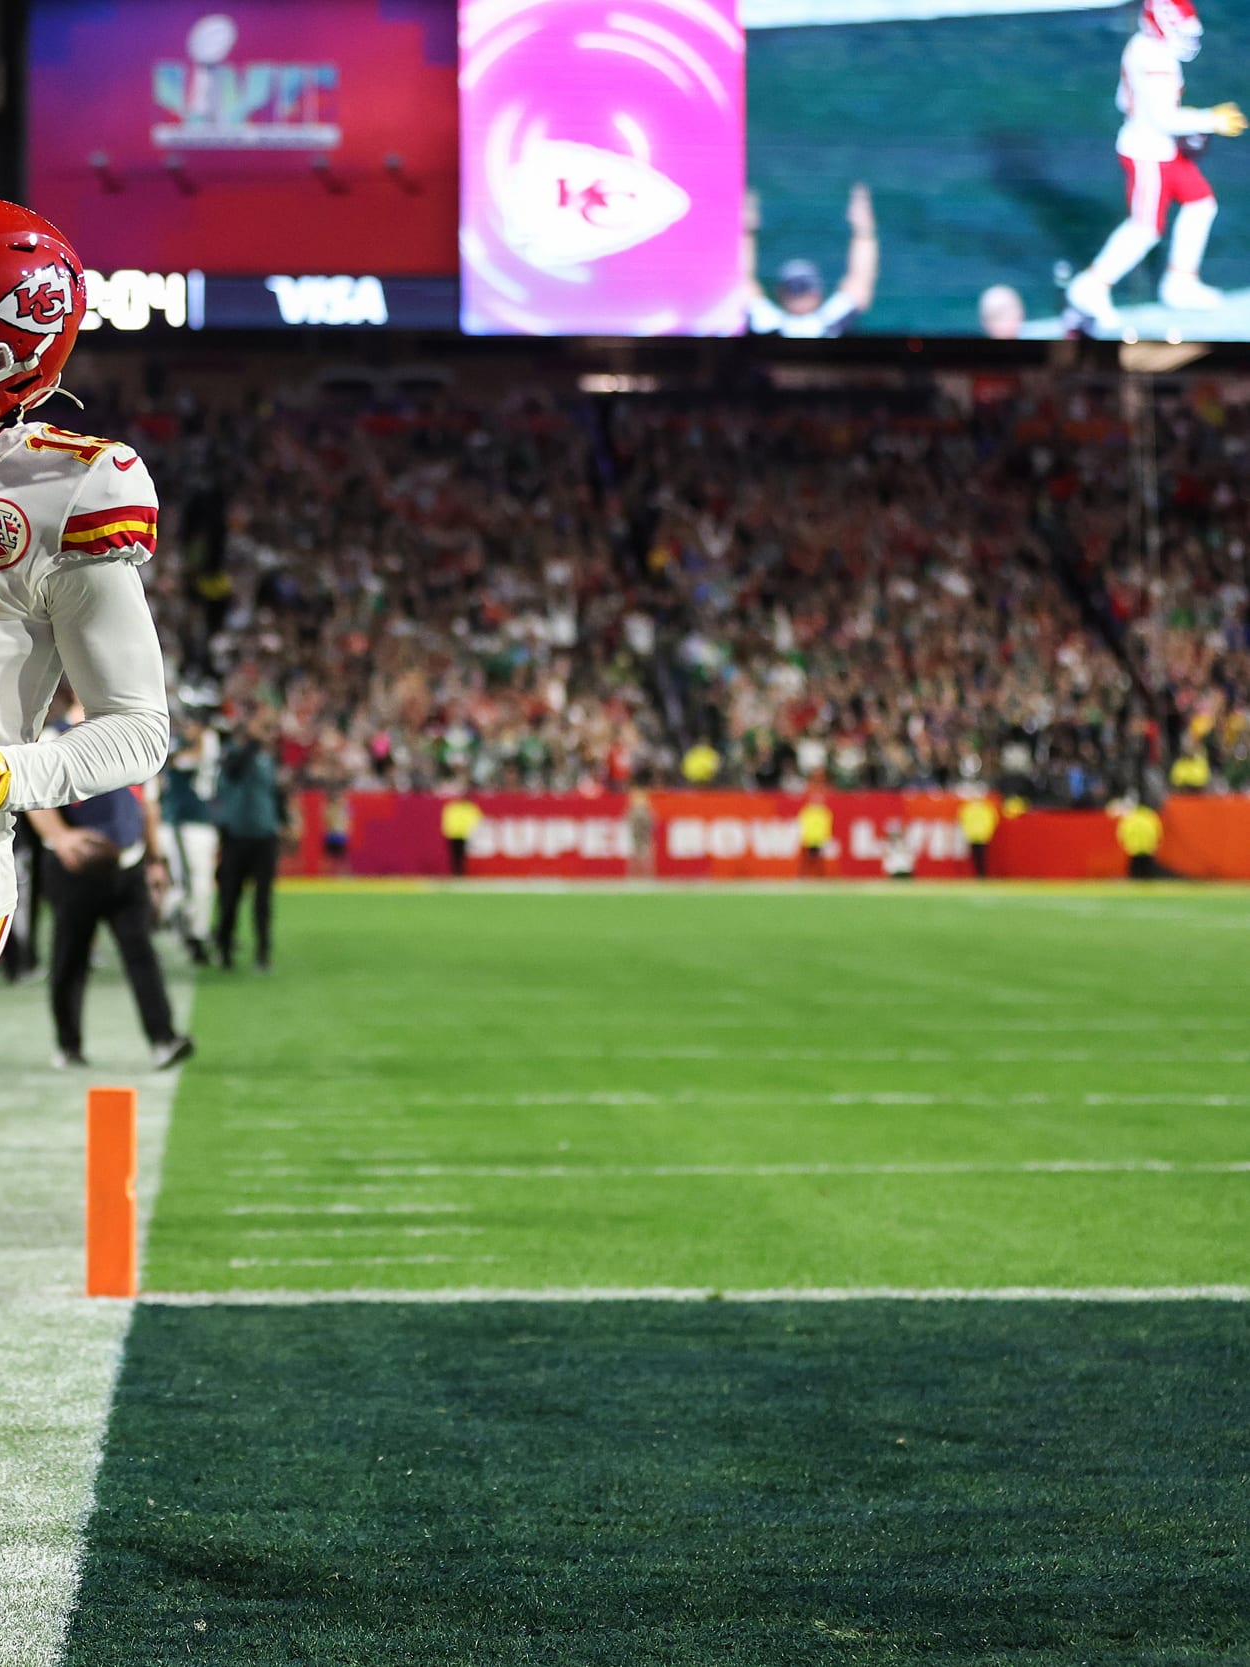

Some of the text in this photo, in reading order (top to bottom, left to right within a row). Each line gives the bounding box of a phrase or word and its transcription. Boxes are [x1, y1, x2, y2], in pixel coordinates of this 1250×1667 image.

[14, 282, 65, 325] KC
[264, 274, 388, 325] VISA
[666, 818, 842, 860] BOW
